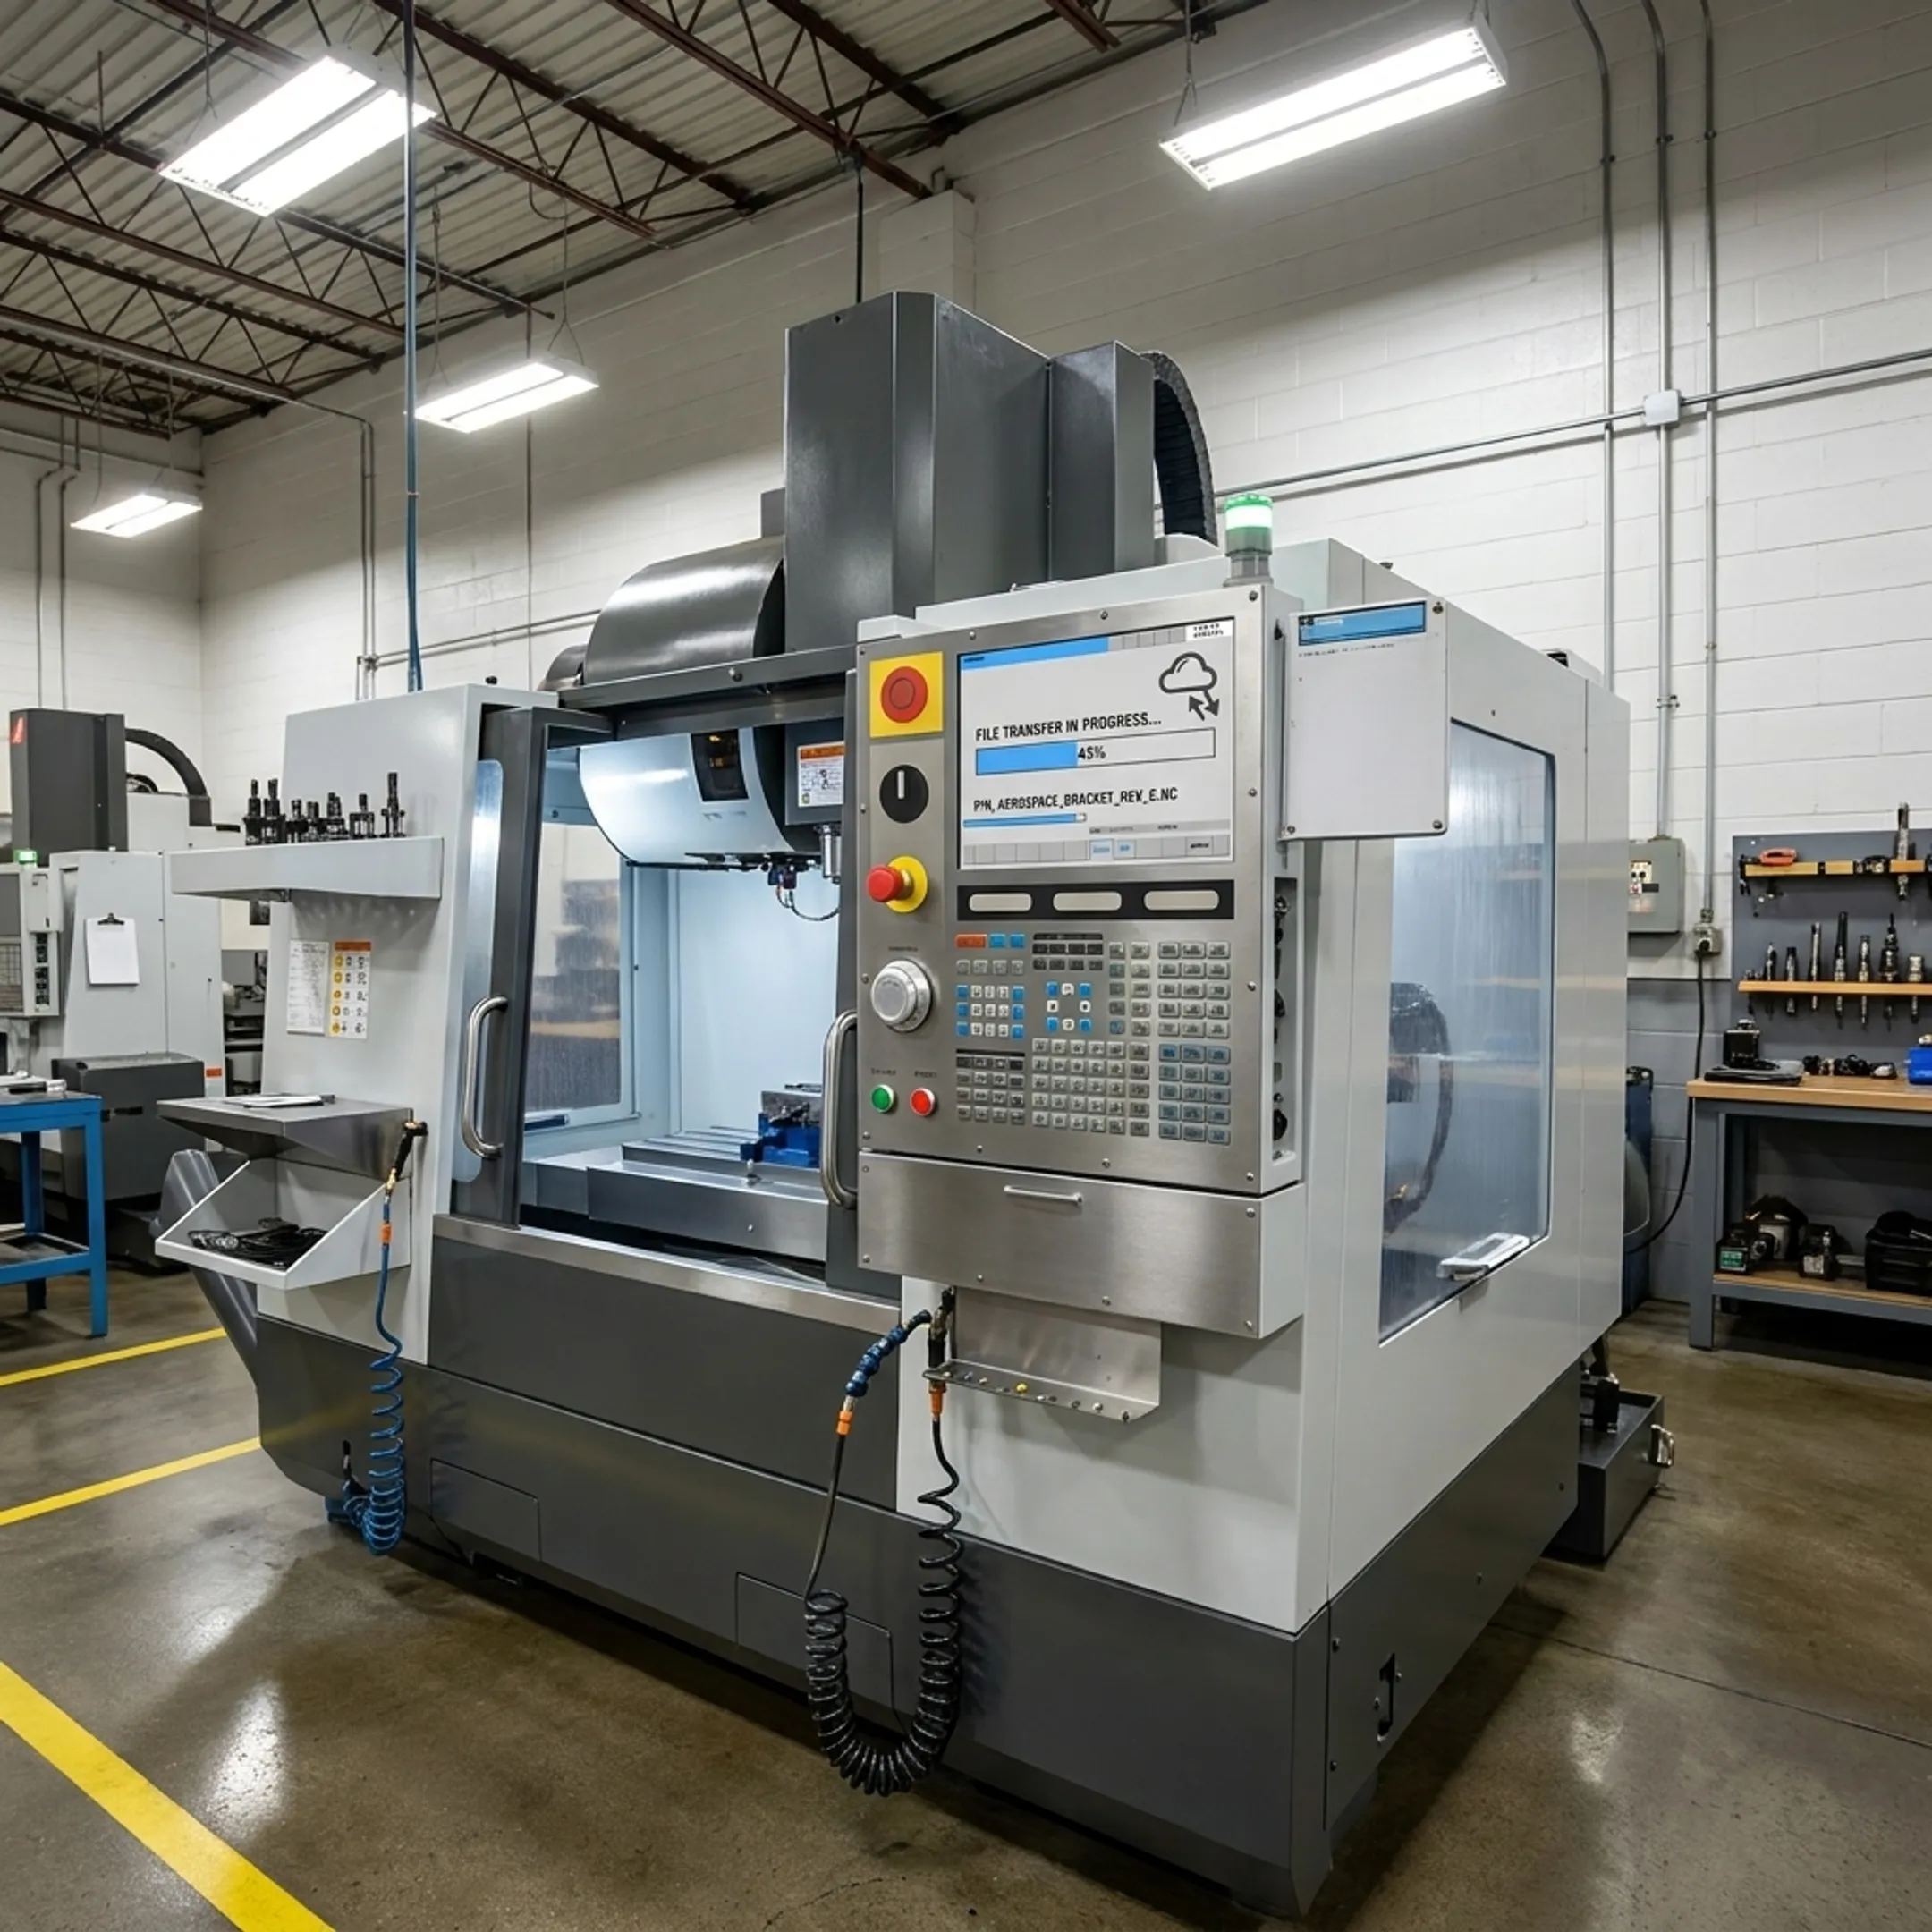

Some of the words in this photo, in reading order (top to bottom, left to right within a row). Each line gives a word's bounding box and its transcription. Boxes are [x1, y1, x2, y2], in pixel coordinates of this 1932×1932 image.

[975, 726, 999, 741] FILE
[1003, 720, 1063, 738] TRANSFER
[1065, 718, 1078, 732] IN
[1082, 712, 1161, 731] PROGRESS...
[1078, 745, 1106, 760] 45%
